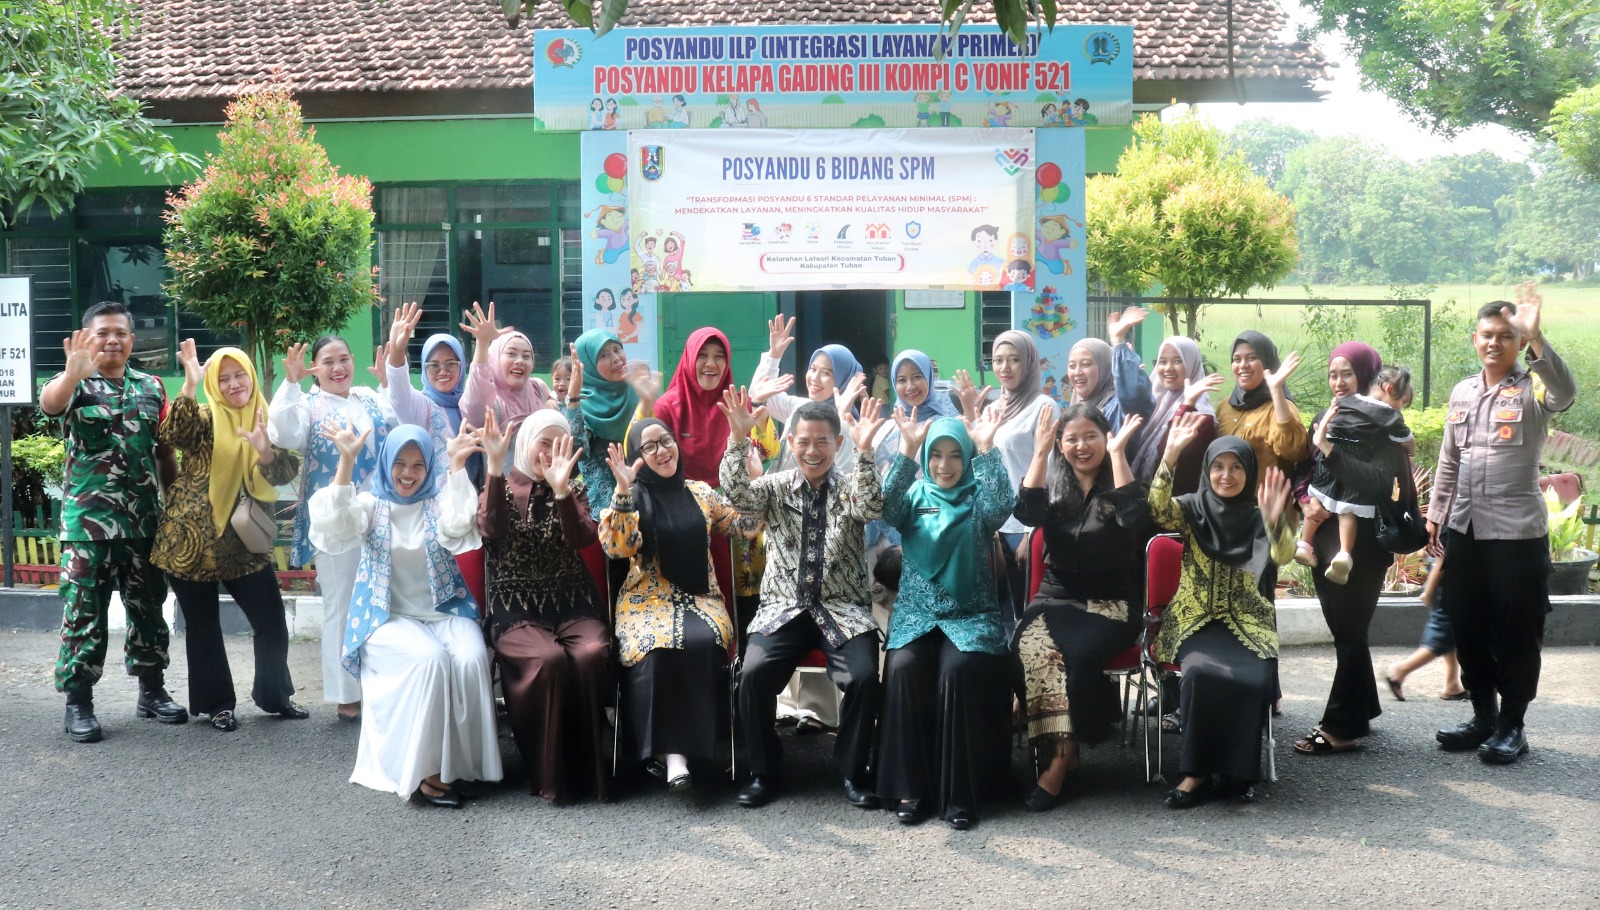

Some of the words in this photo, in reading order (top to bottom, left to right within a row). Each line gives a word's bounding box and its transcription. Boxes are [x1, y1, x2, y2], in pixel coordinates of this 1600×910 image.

[626, 37, 724, 61] POSYANDU
[729, 36, 757, 60] ILP
[761, 35, 867, 59] (INTEGRASI
[594, 65, 697, 94] POSYANDU
[702, 65, 774, 93] KELAPA
[778, 63, 853, 92] GADING
[859, 63, 880, 91] III
[885, 62, 950, 91] KOMPI
[955, 62, 969, 91] C
[972, 62, 1030, 91] YONIF
[1034, 62, 1070, 90] 521
[722, 157, 810, 181] POSYANDU
[816, 156, 826, 180] 6
[831, 156, 894, 180] BIDANG
[899, 156, 935, 180] SPM
[757, 195, 805, 203] POSYANDU
[948, 195, 972, 204] (SPM)
[675, 206, 739, 215] MENDEKATKAN
[740, 206, 783, 214] LAYANAN,
[10, 347, 26, 359] 521
